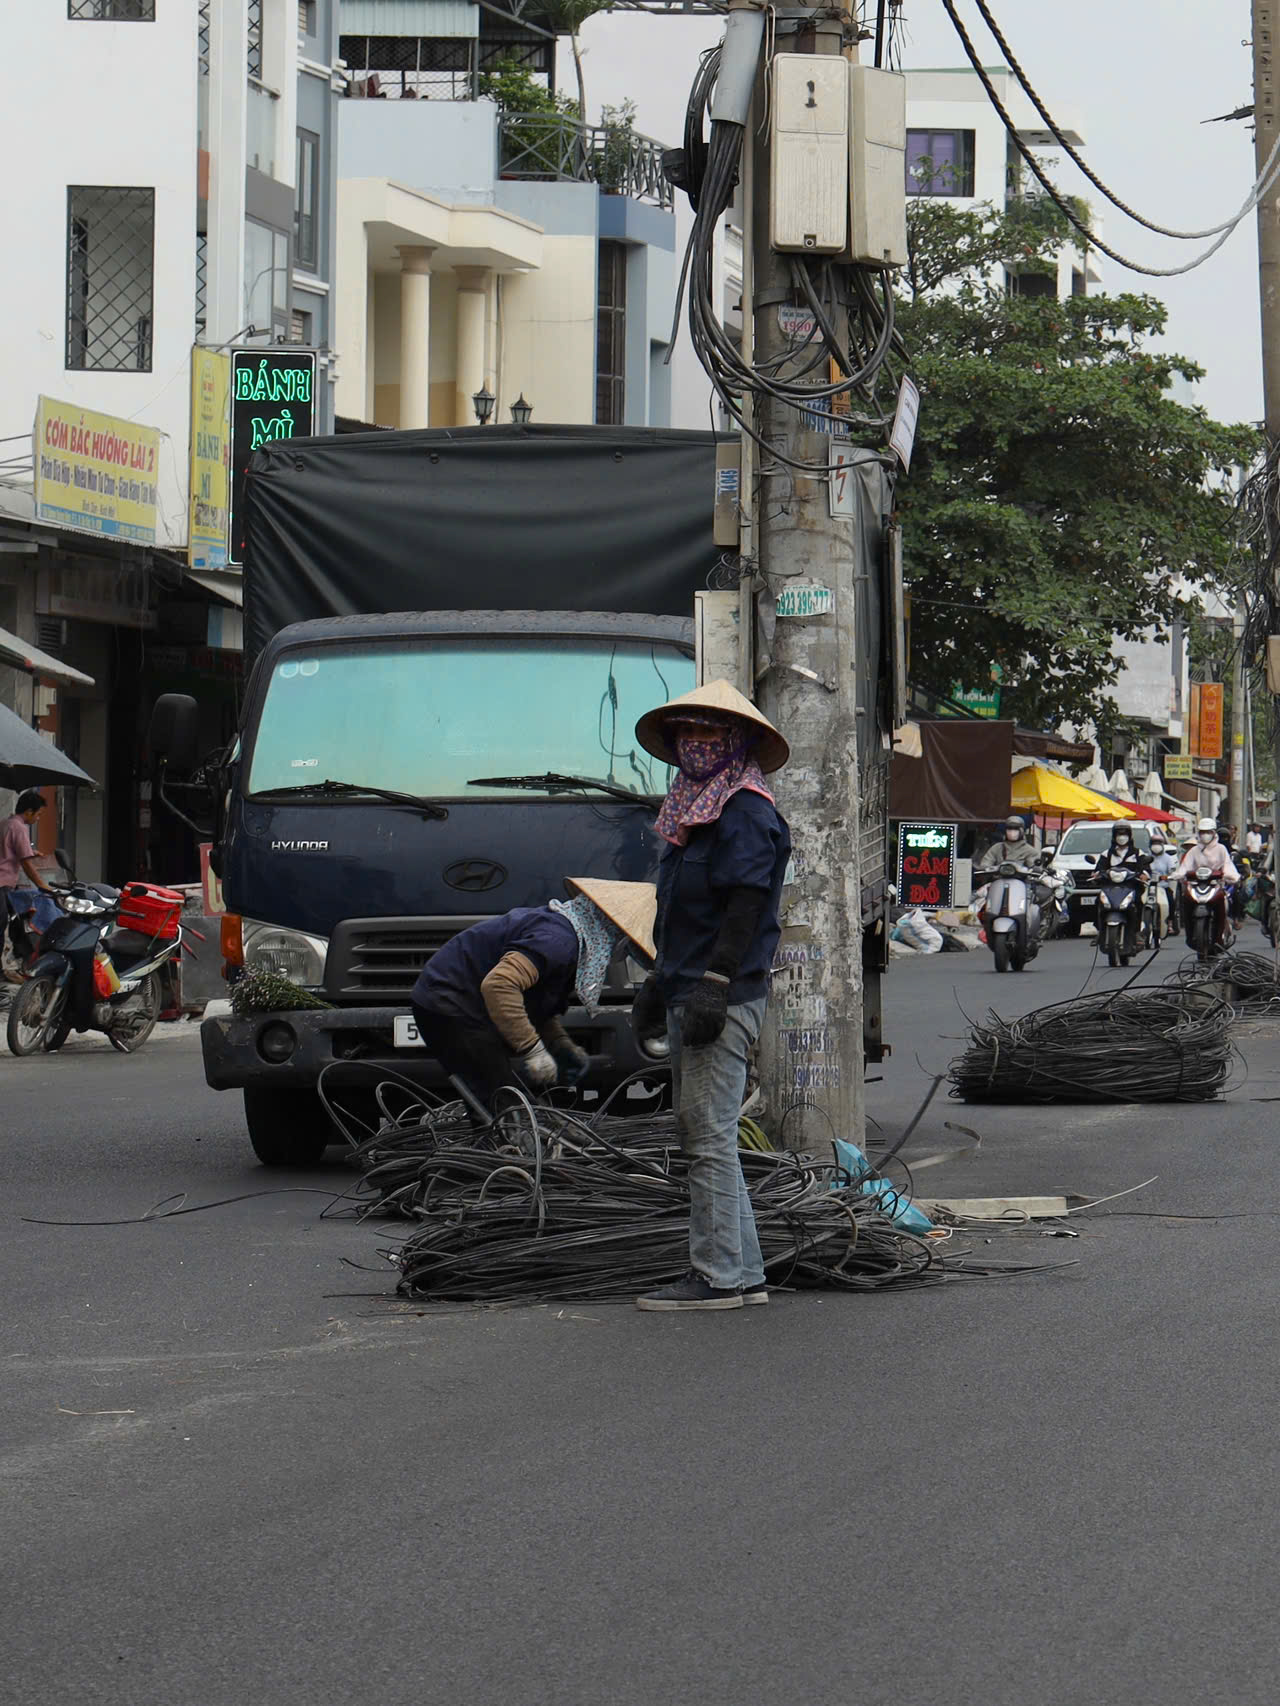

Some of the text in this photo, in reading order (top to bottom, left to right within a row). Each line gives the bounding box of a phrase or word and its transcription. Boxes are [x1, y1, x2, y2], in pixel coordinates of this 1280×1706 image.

[236, 359, 311, 402] BÁNH
[45, 416, 69, 450] CƠM
[92, 429, 129, 466] HƯƠNG
[149, 447, 155, 473] 2
[250, 409, 294, 451] MÌ
